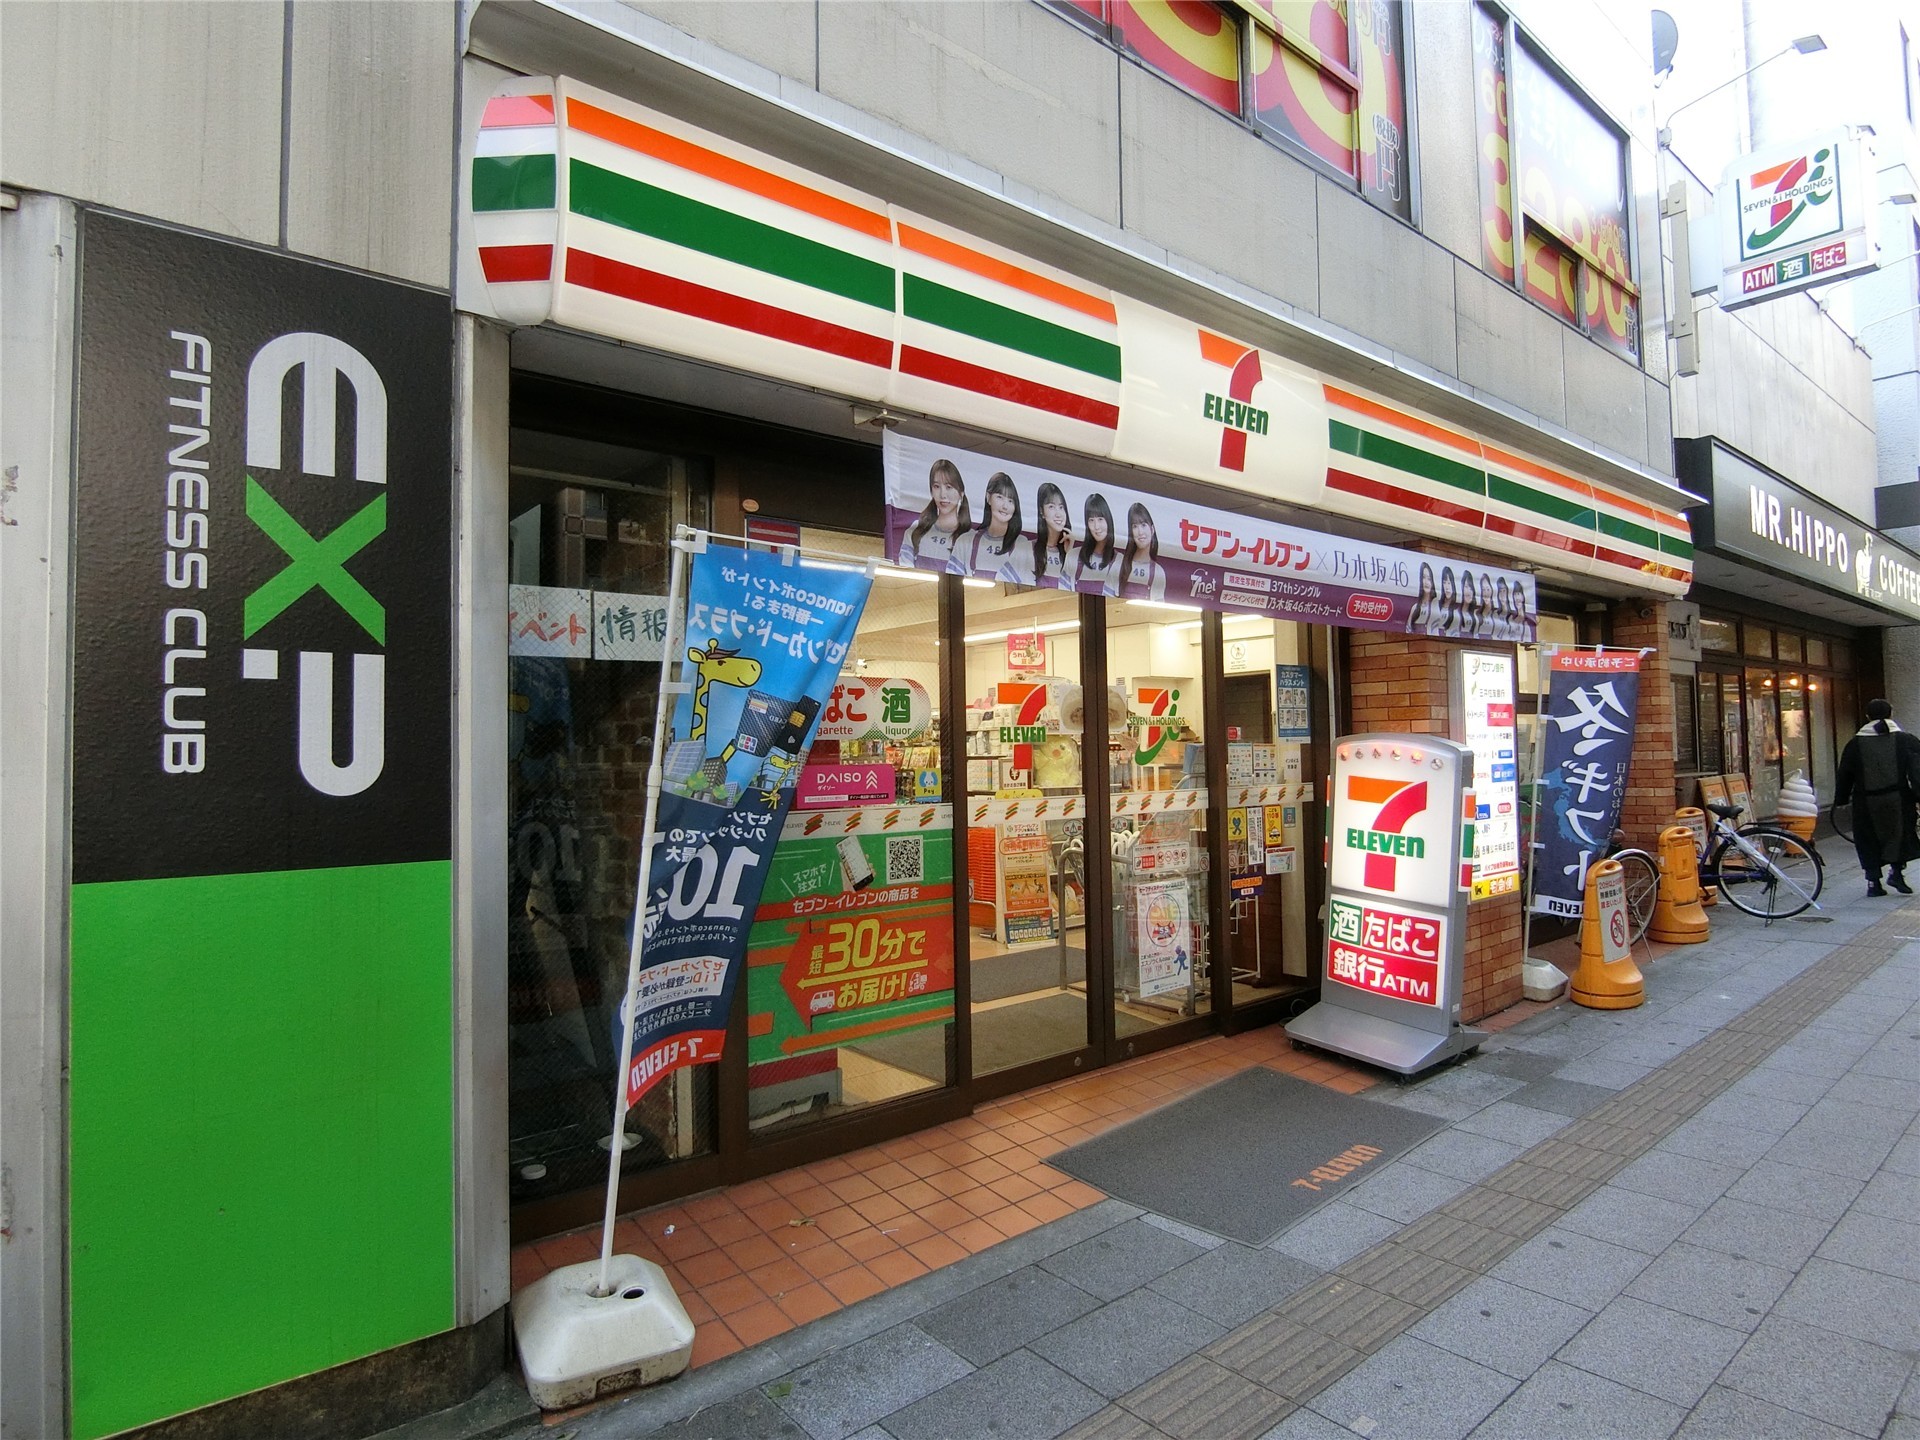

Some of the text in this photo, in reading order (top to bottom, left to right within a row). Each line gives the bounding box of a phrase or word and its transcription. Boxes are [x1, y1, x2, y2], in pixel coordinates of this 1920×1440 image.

[1784, 176, 1834, 200] HOLDINGS
[1744, 246, 1846, 291] ATM 酒 たばこ
[163, 330, 211, 775] FITNESS CLUB
[1179, 518, 1311, 571] セブン-イレブン
[1333, 550, 1409, 588] 乃木坂46
[601, 605, 667, 643] 情報
[1267, 598, 1343, 617] 乃木坂46ポストカード
[1353, 601, 1388, 616] 予約受付中
[882, 687, 911, 723] 酒
[885, 725, 912, 736] liquor
[817, 772, 862, 784] DAISO
[793, 864, 827, 883] スマホで
[793, 887, 919, 914] セブン-イレブンの商品を
[808, 918, 926, 976] 最短 30分で
[1331, 902, 1436, 957] 酒 たばこ
[837, 972, 907, 1008] お届け!
